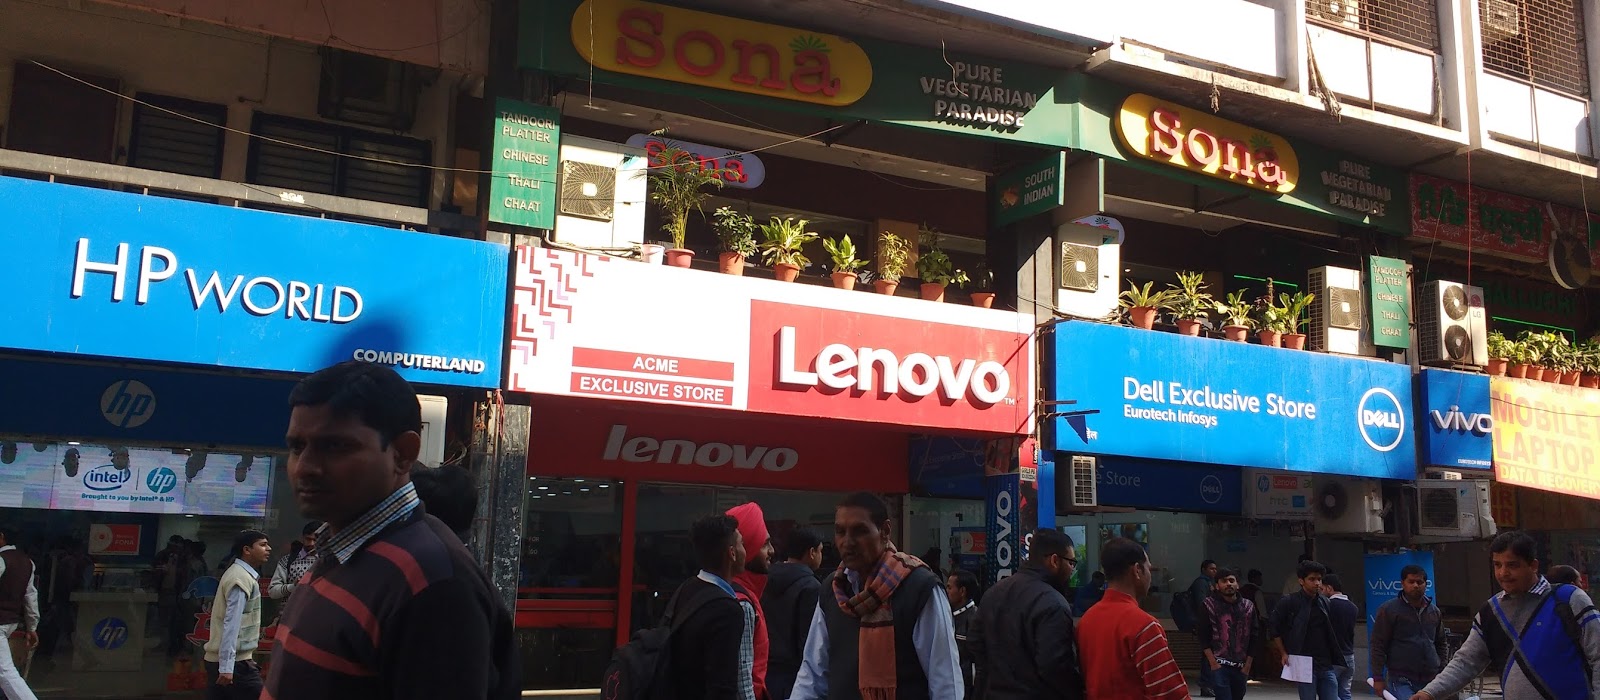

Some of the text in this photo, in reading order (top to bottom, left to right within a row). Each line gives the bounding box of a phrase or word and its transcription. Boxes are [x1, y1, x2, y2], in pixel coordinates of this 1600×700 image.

[616, 6, 841, 98] Sona
[954, 61, 1003, 84] PURE
[919, 76, 1037, 109] VEGETARIAN
[501, 111, 556, 131] TANDOORI
[934, 99, 1025, 127] PARADISE
[502, 125, 551, 144] PLATTER
[1152, 106, 1287, 186] Sona
[502, 149, 549, 167] CHINESE
[645, 139, 749, 184] Sona
[507, 174, 541, 190] THALI
[1024, 166, 1055, 189] SOUTH
[1339, 160, 1371, 181] PURE
[1023, 183, 1054, 206] INDIAN
[1320, 170, 1392, 202] VEGETARIAN
[503, 196, 541, 213] CHAAT
[1329, 191, 1386, 217] PARADISE
[71, 237, 363, 324] HP WORLD
[1372, 265, 1405, 278] TANDOORI
[1374, 275, 1402, 286] PLATTER
[1376, 292, 1403, 303] CHINESE
[1381, 310, 1400, 321] THALI
[1472, 310, 1481, 318] LG
[1380, 326, 1402, 337] CHAAT
[352, 348, 485, 375] COMPUTERLAND
[632, 355, 679, 374] ACME
[775, 325, 1011, 405] Lenovo
[579, 376, 725, 402] EXCLUSIVE STORE
[1123, 376, 1316, 420] Dell Exclusive Store
[105, 379, 153, 428] hp
[1491, 390, 1591, 440] MOBILE
[1123, 404, 1218, 427] Eurotech Infosys
[1363, 408, 1400, 430] DELL
[1430, 405, 1493, 433] vivo
[603, 423, 799, 472] lenovo
[1494, 427, 1595, 474] LAPTOP
[90, 469, 123, 483] intel
[148, 467, 175, 493] hp
[1106, 471, 1141, 487] Store
[1273, 477, 1297, 487] Lenovo
[1500, 464, 1535, 484] DATA
[81, 493, 107, 501] Brought
[130, 495, 138, 503] by
[996, 490, 1012, 583] novo
